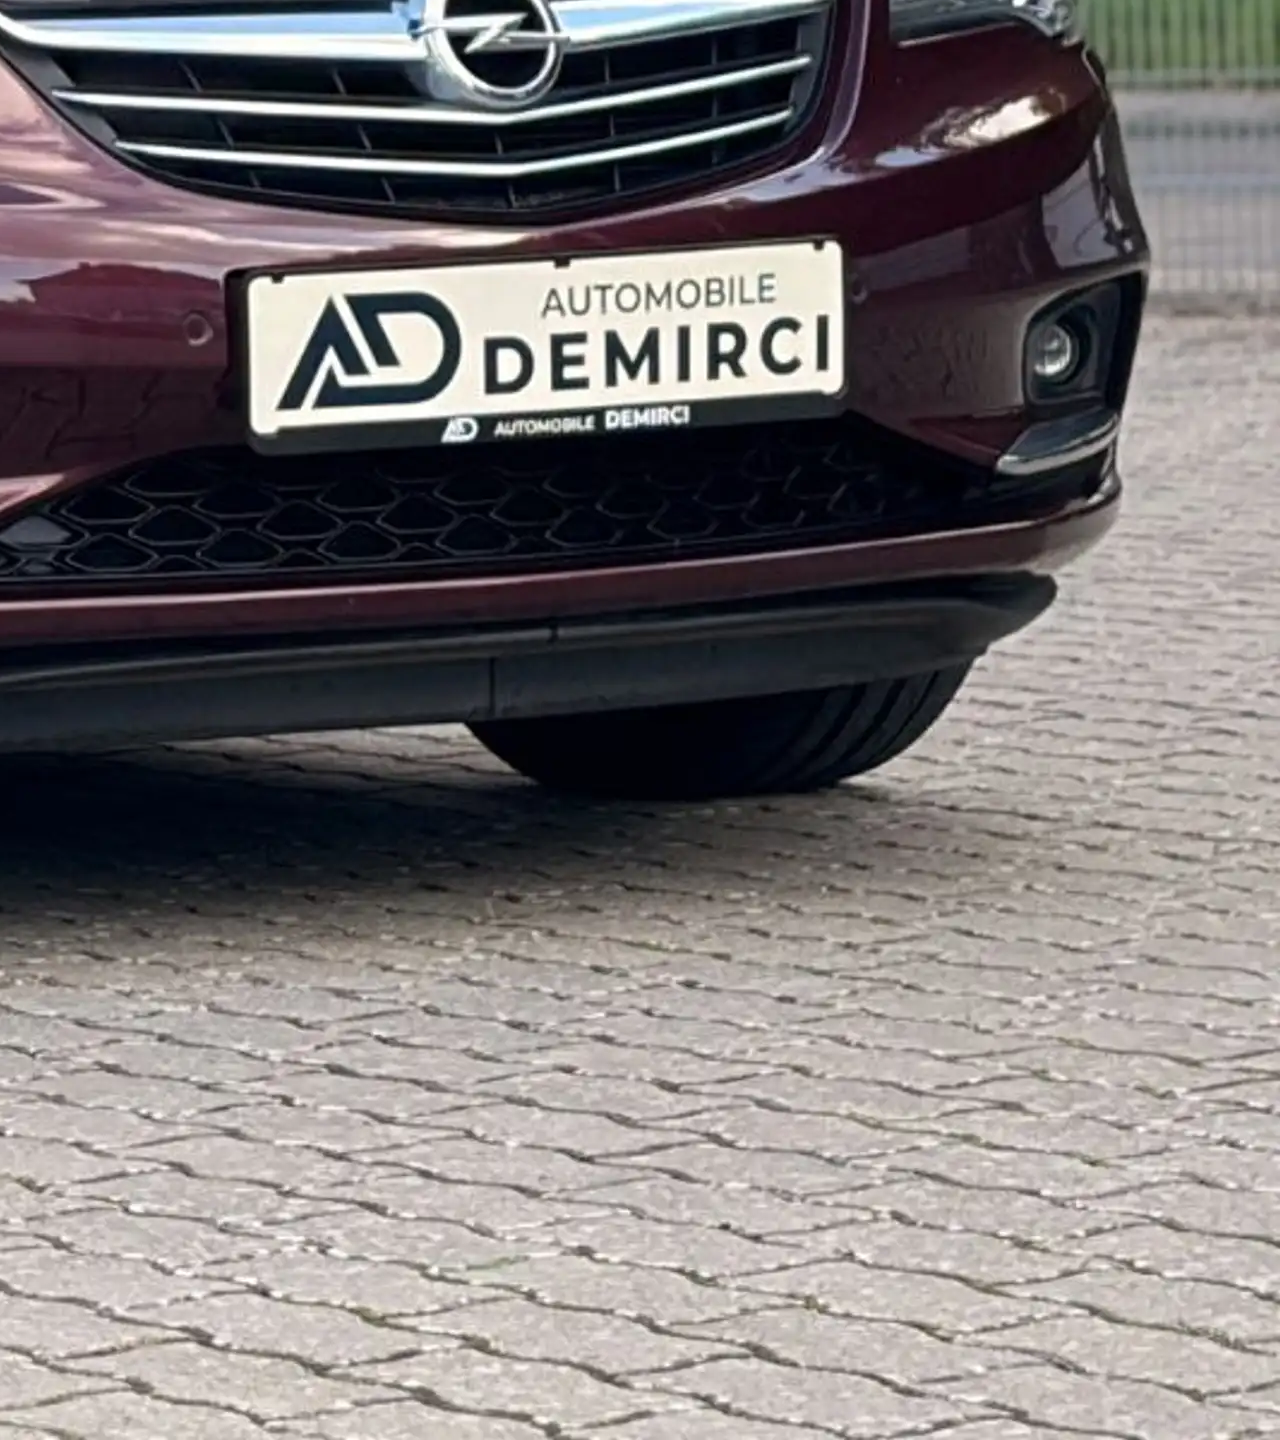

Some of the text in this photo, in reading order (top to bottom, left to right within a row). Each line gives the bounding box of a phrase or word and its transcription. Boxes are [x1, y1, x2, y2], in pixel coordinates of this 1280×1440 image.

[541, 273, 777, 317] AUTOMOBILE
[483, 314, 830, 395] DEMIRCI
[494, 415, 596, 436] AUTOMOBILE
[604, 405, 692, 429] DEMIRCI
